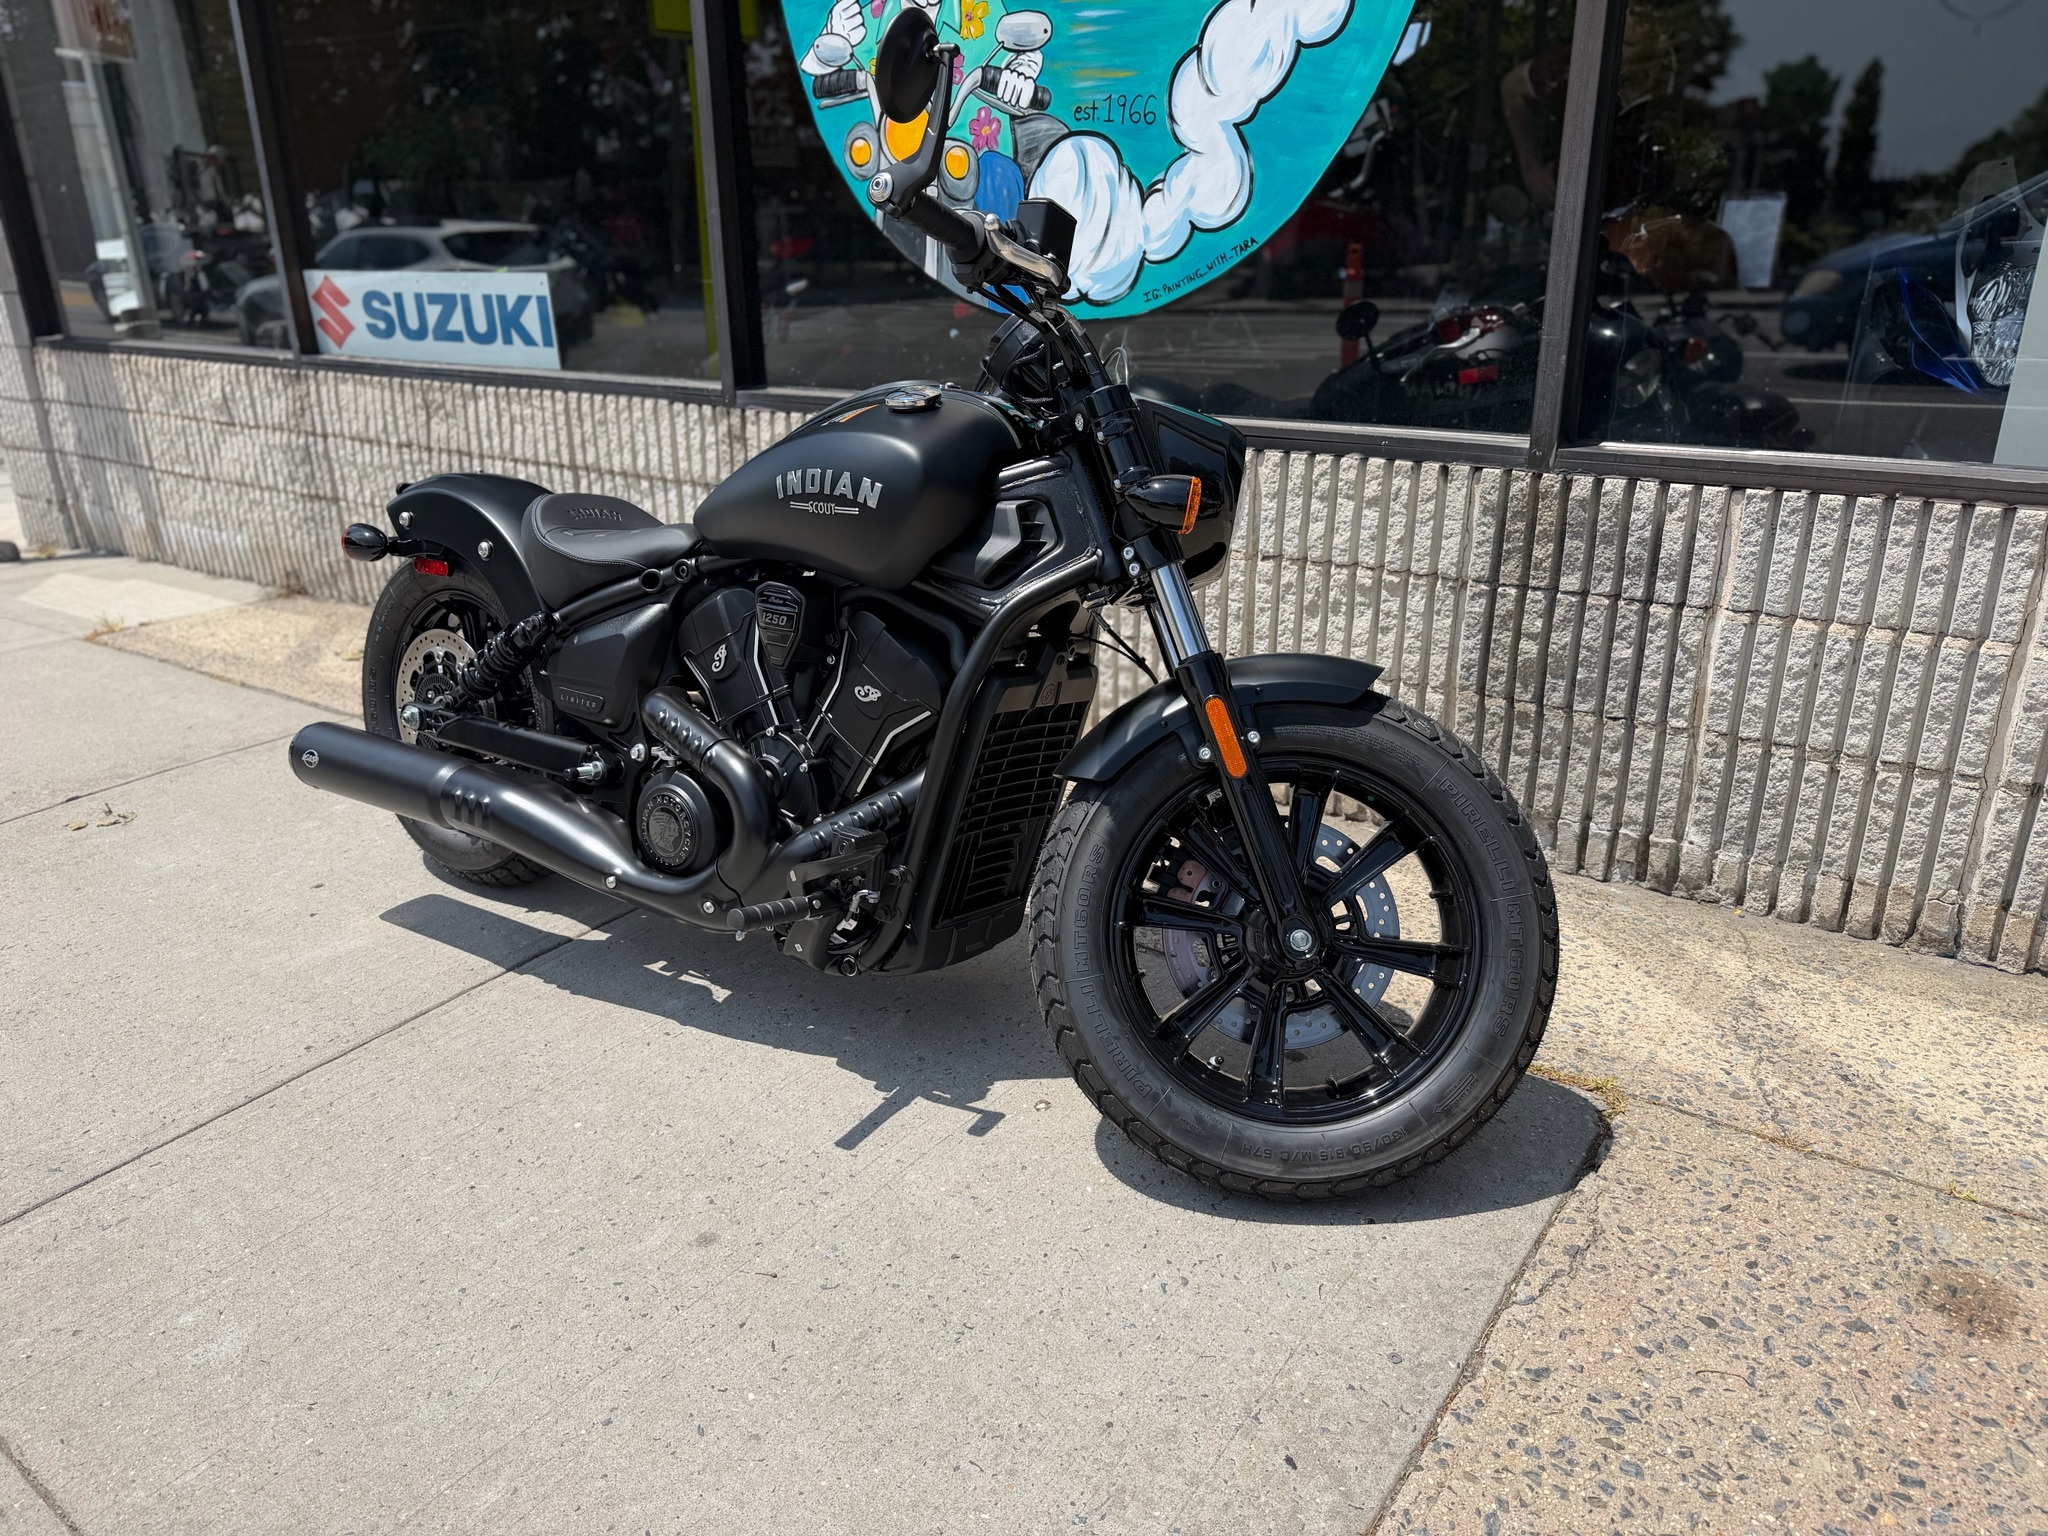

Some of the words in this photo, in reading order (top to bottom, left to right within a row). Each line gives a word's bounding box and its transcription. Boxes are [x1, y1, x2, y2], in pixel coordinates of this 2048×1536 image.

[1102, 94, 1158, 125] 1966
[1162, 235, 1259, 295] PAINTING_WITH_TARA
[361, 290, 554, 348] SUZUKI
[776, 467, 883, 509] INDIAN
[808, 501, 836, 515] SCOUT
[762, 612, 787, 625] 1250
[560, 693, 596, 708] LIMITED
[656, 795, 692, 859] MOTORCYCLE
[1074, 843, 1106, 973] MT60RS
[1437, 777, 1517, 892] PIRELLI
[1492, 902, 1526, 1038] MT60RS
[1080, 982, 1153, 1099] PIRELLI
[1279, 1149, 1312, 1162] M/C
